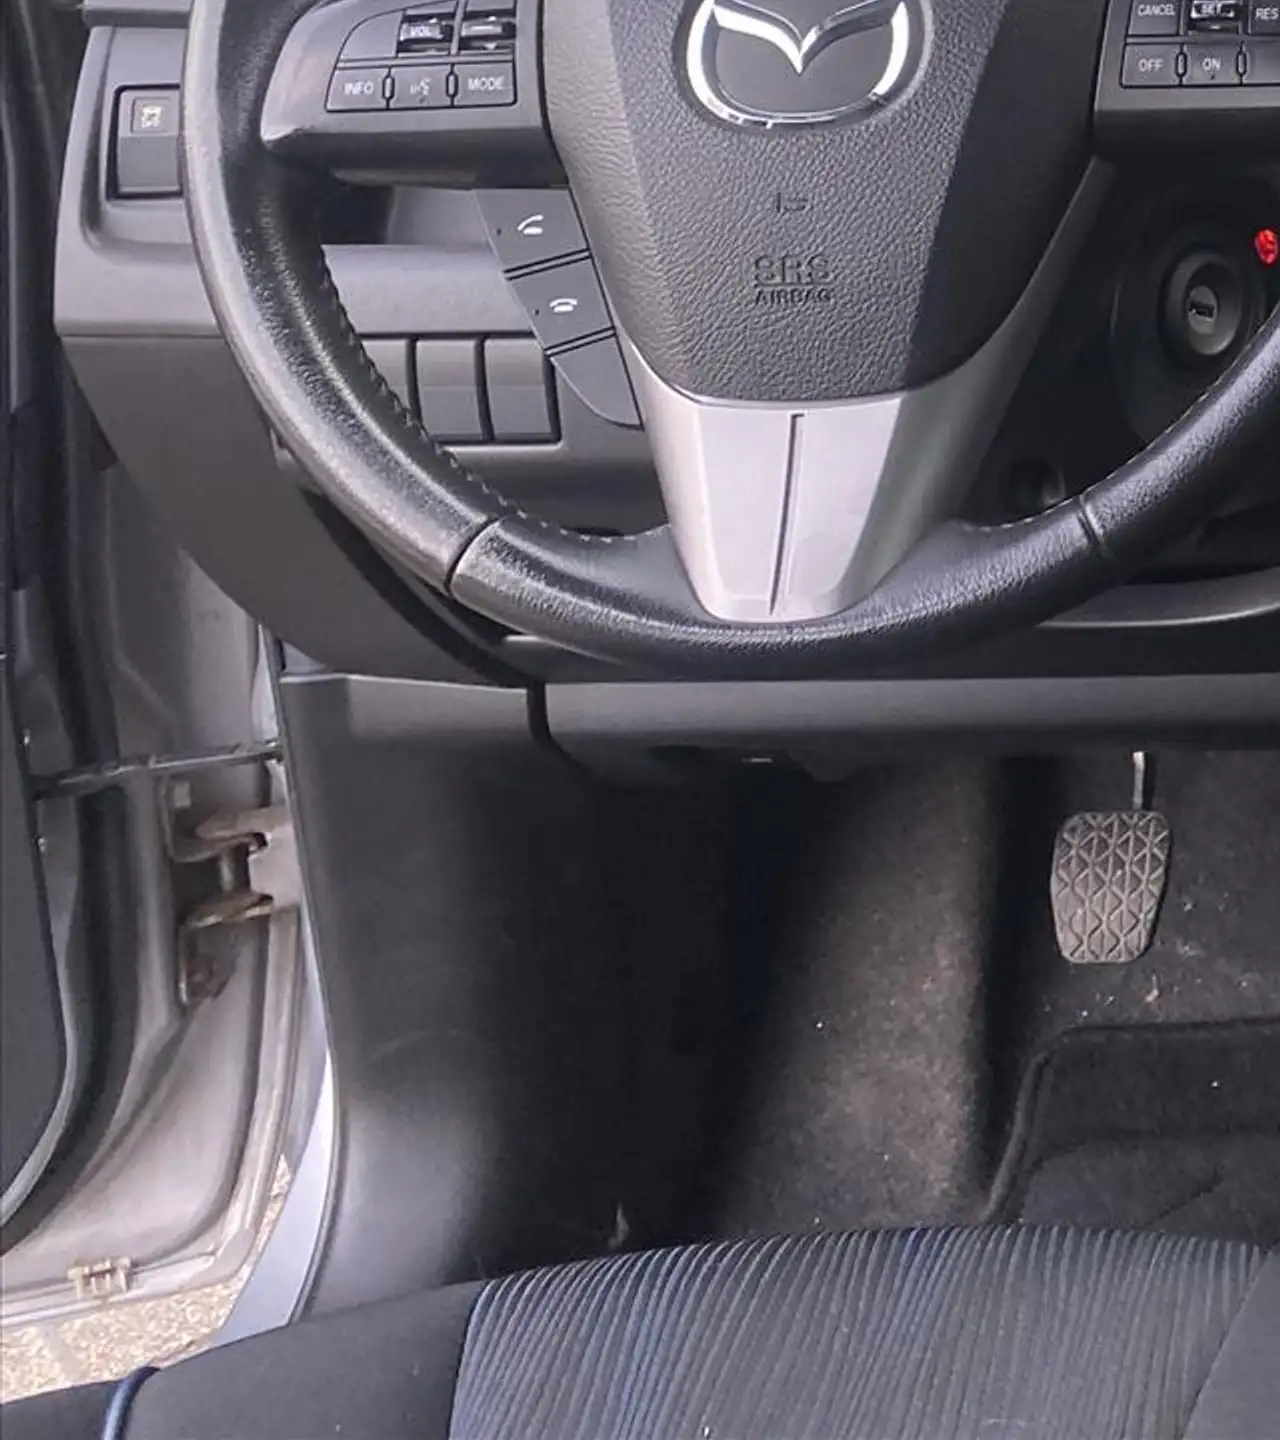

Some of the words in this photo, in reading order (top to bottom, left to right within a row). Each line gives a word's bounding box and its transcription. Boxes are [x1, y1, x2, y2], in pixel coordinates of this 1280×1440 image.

[1138, 4, 1175, 16] CANCEL
[1255, 8, 1279, 20] RES
[1138, 59, 1164, 72] OFF
[1202, 59, 1221, 71] ON
[344, 83, 374, 95] INFO
[468, 77, 505, 91] MODE
[755, 288, 831, 306] AIRBAG
